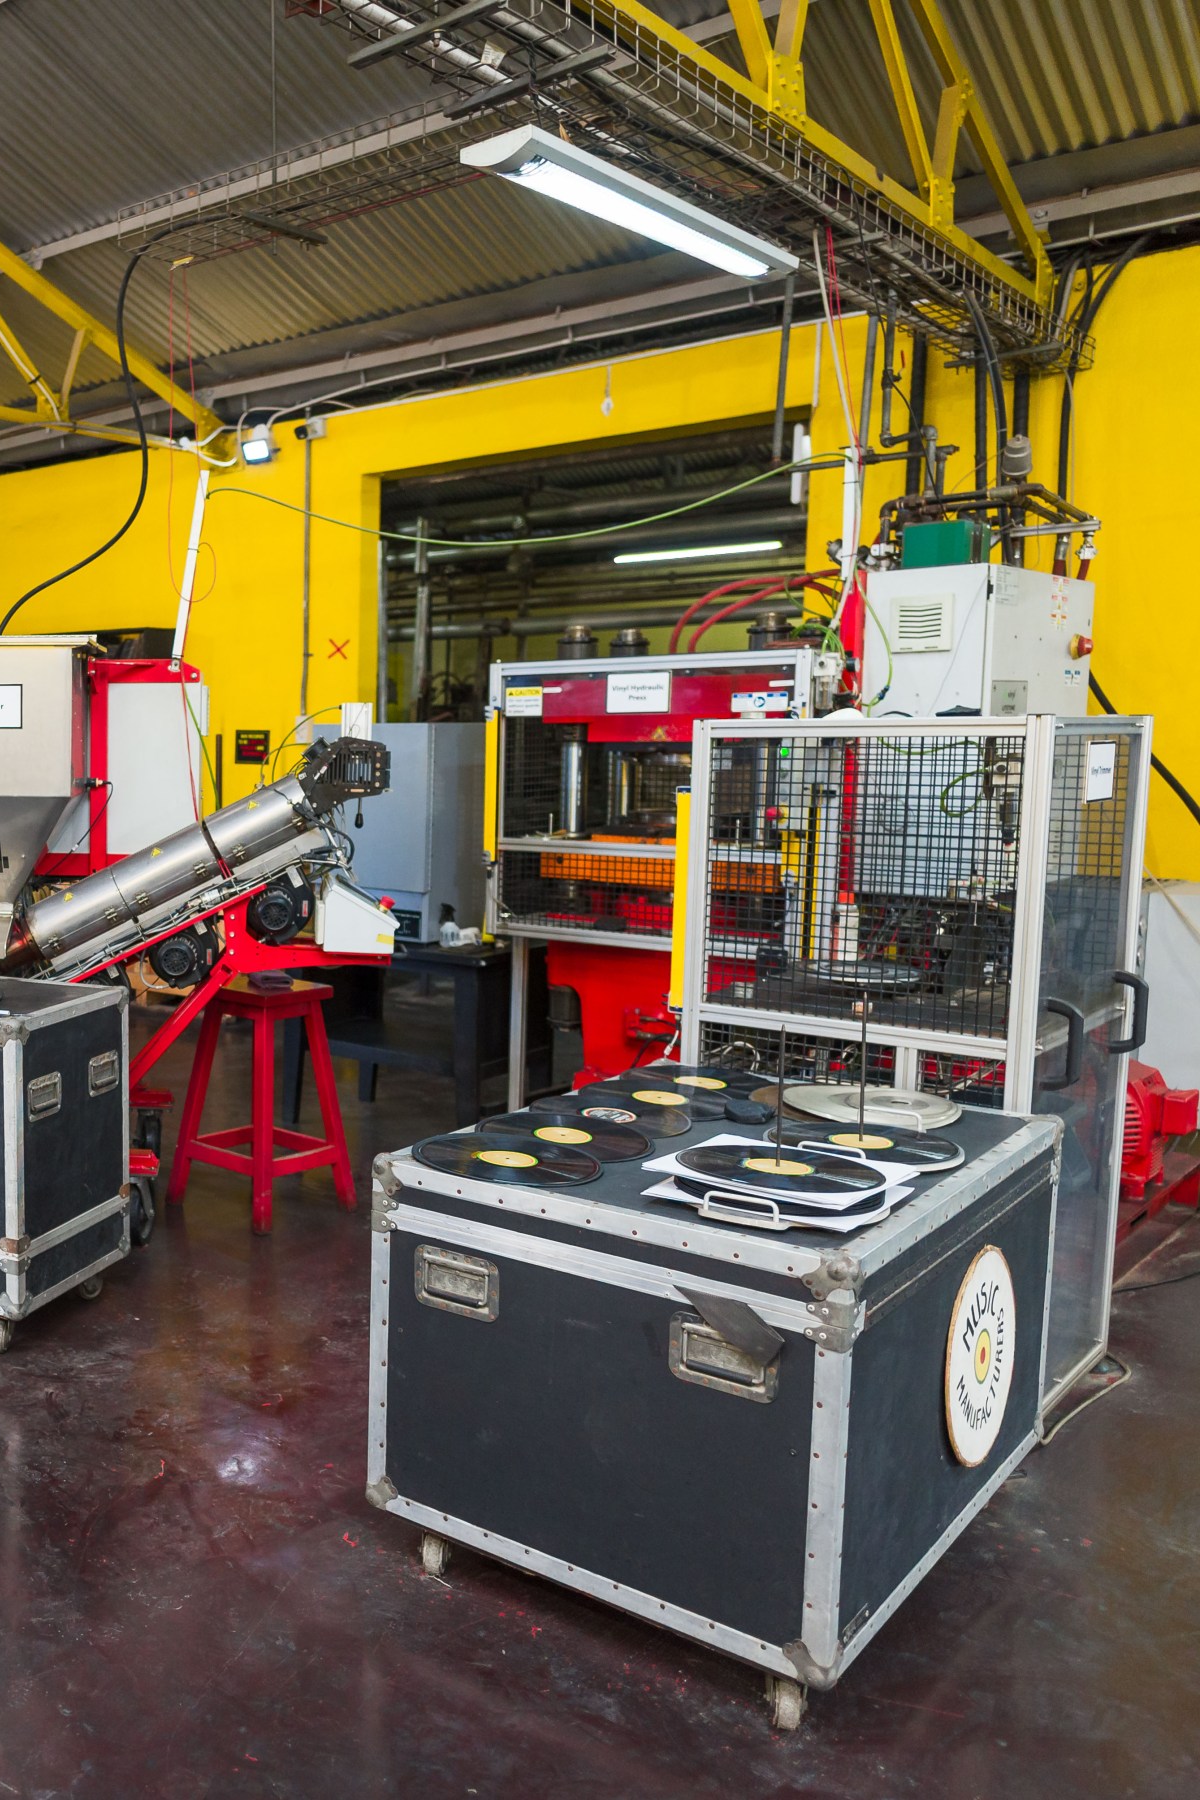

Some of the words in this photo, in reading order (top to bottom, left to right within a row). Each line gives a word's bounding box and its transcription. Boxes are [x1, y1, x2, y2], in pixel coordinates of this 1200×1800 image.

[612, 685, 629, 693] Vinyl
[630, 684, 664, 693] Hydraulic
[962, 1280, 1000, 1352] MUSIC
[956, 1307, 1005, 1431] MANUFACTURERS
